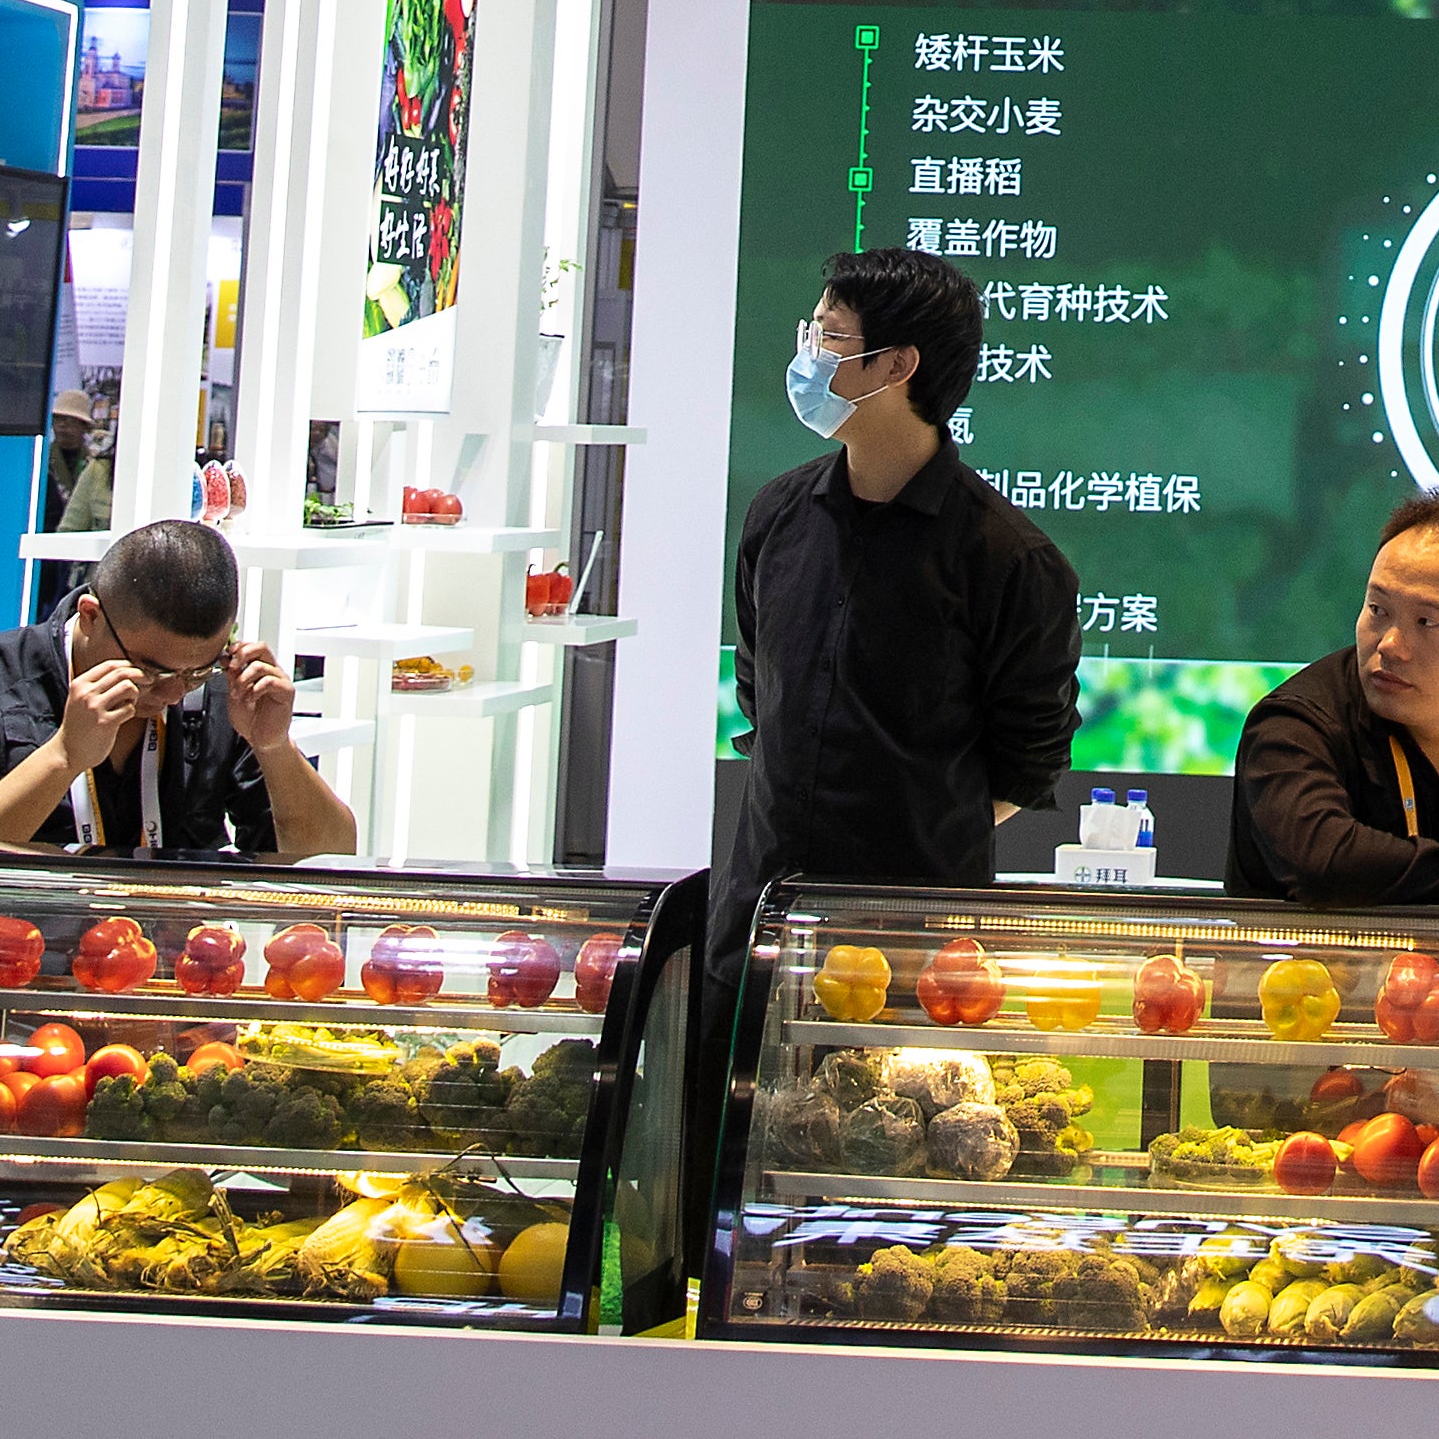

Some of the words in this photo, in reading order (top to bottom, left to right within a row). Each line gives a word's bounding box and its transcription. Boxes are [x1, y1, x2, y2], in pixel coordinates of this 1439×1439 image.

[914, 33, 1066, 75] 矮杆玉米
[911, 94, 1063, 137] 杂交小麦
[908, 156, 1023, 197] 直播稻
[905, 217, 1059, 259] 覆盖作物
[1095, 866, 1128, 884] 拜耳
